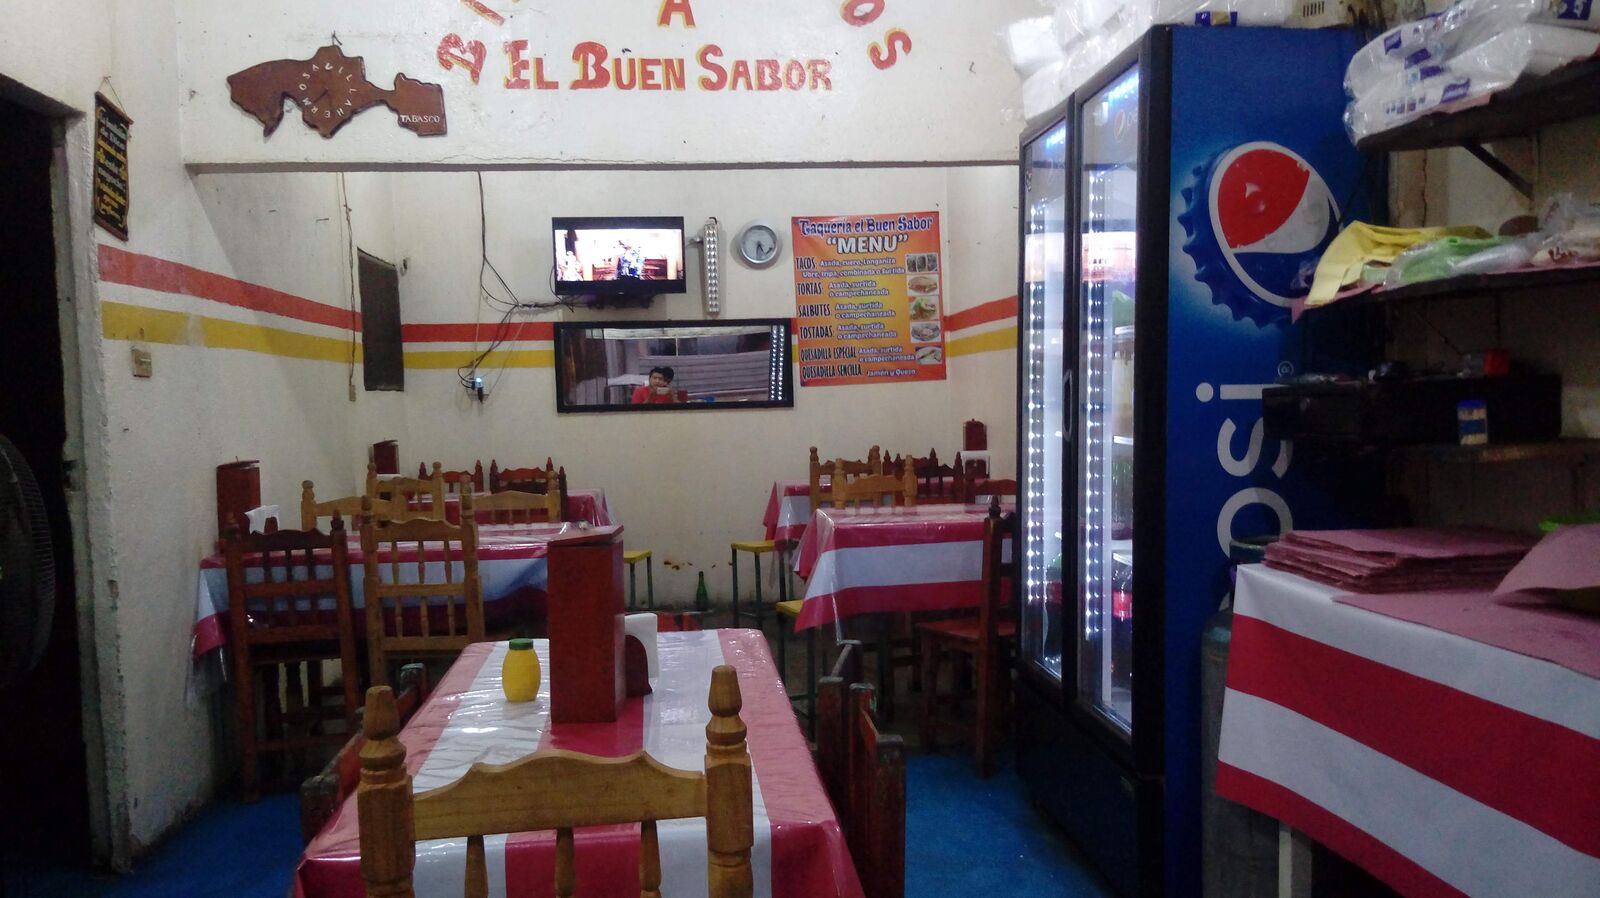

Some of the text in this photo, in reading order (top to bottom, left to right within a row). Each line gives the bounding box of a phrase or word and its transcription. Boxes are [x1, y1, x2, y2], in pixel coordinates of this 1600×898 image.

[503, 40, 559, 89] EL
[570, 41, 686, 91] BUEN
[698, 43, 833, 91] SABOR
[400, 114, 441, 124] TABASCO
[854, 219, 864, 232] el
[866, 217, 895, 232] Buen
[897, 215, 933, 231] Sabor
